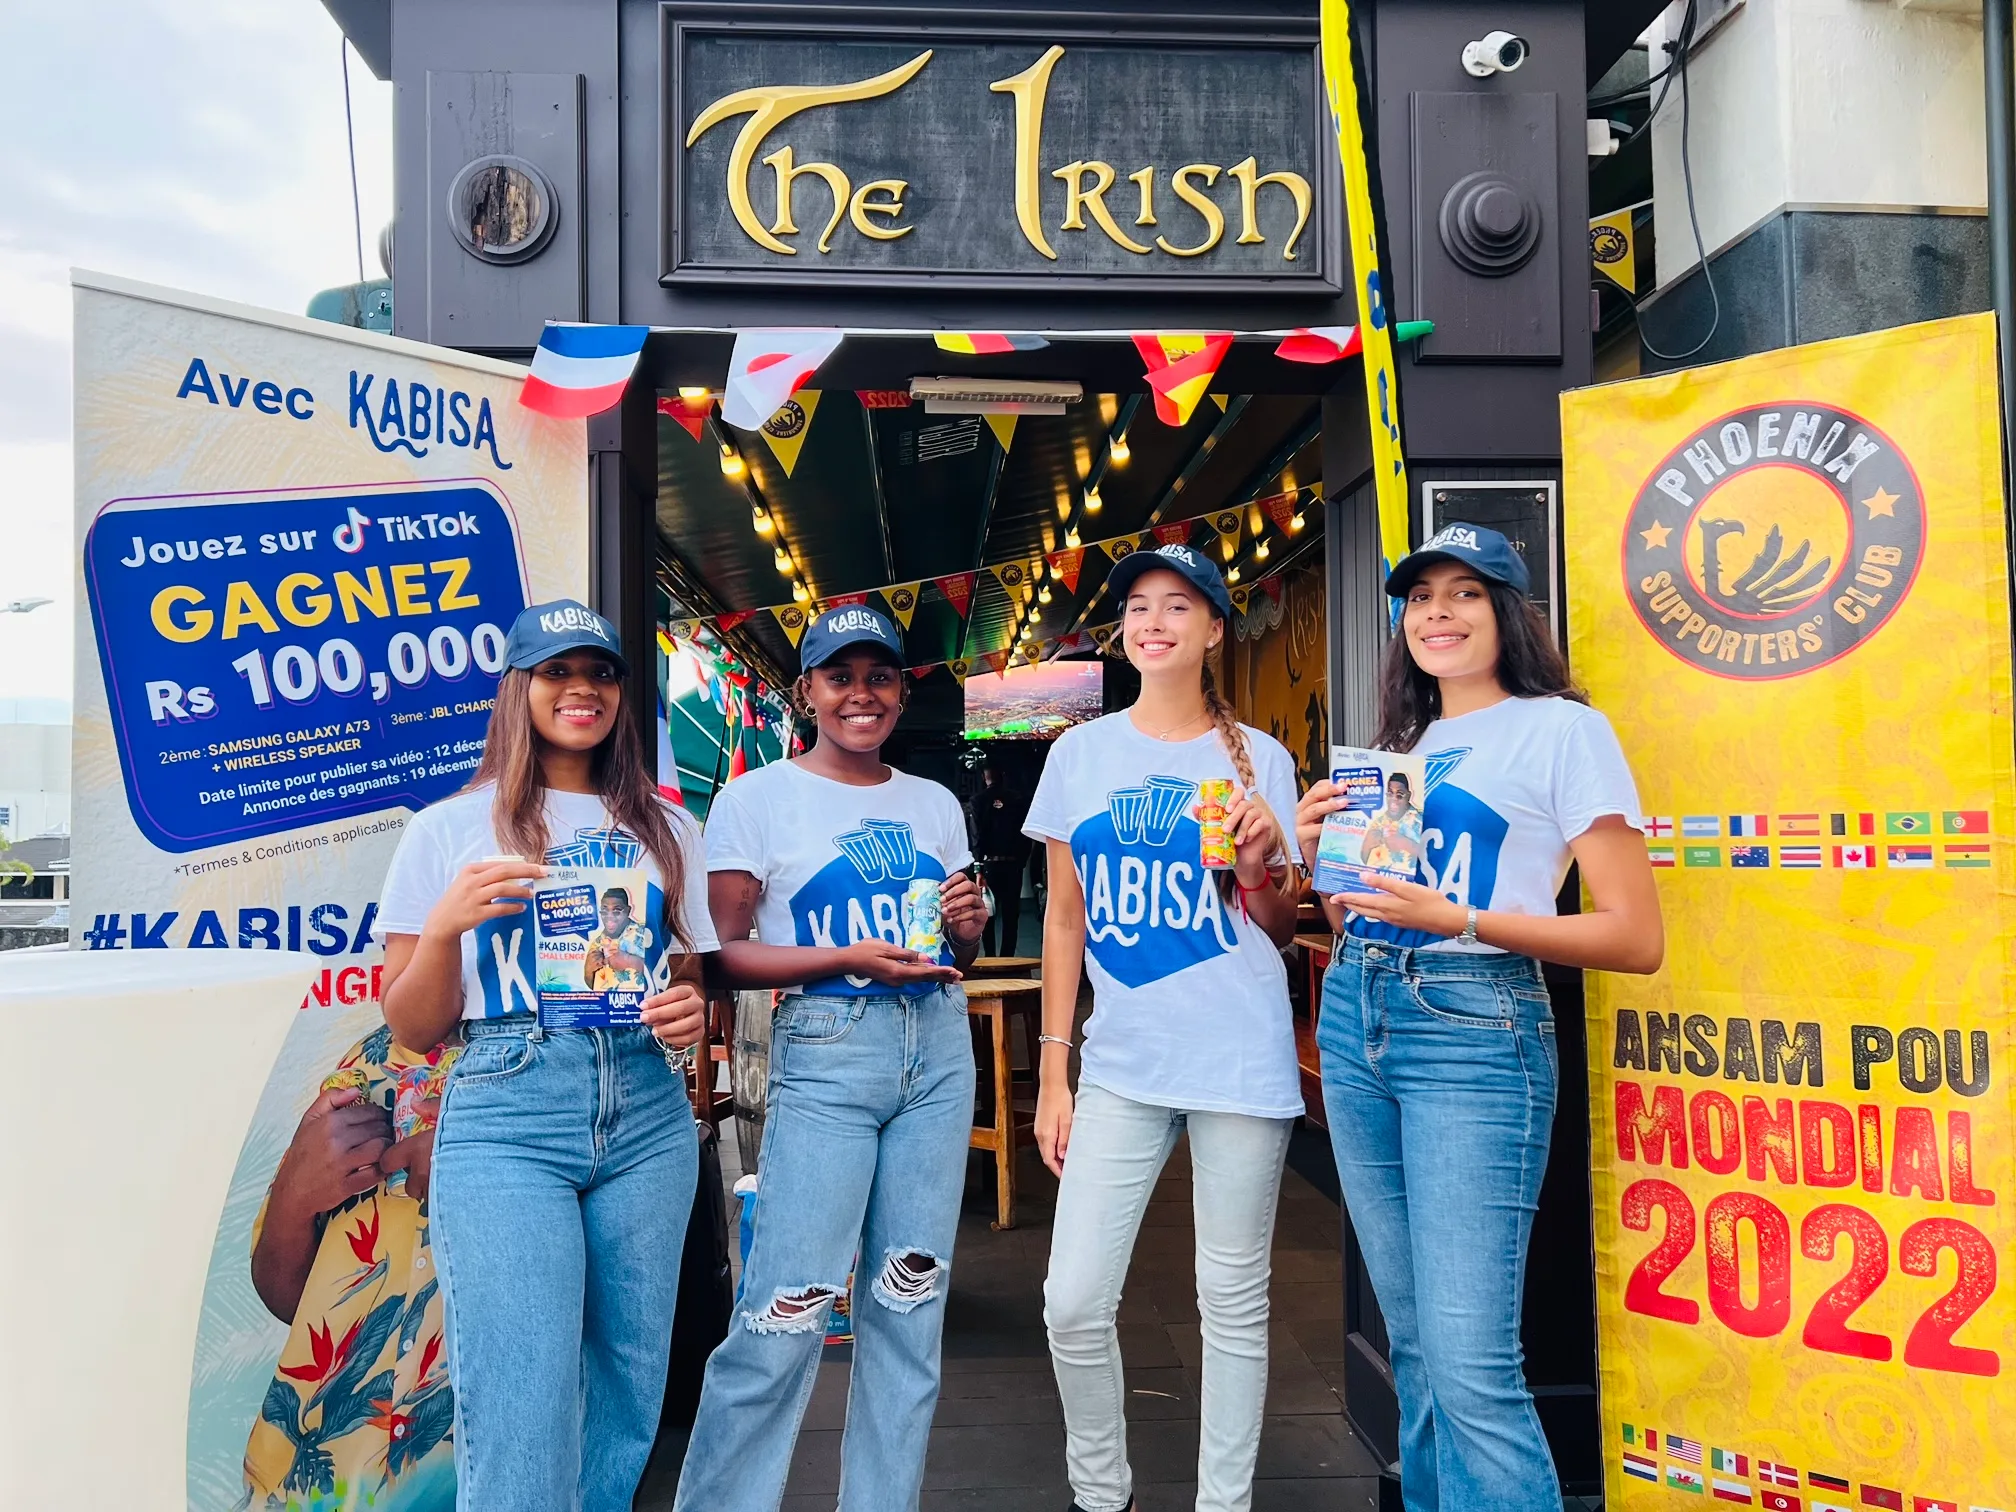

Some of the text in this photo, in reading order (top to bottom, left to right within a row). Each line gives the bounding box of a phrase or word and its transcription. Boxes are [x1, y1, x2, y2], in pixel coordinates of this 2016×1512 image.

[686, 48, 933, 255] The
[176, 357, 512, 470] Avec KABISA
[1655, 411, 1880, 507] PHOENIX
[120, 510, 481, 569] Jouez sur TikTok
[150, 556, 480, 643] GAGNEZ
[1641, 545, 1903, 665] SUPPORTERS' CLUB
[539, 607, 610, 642] KABISA
[828, 610, 886, 639] KABISA
[145, 621, 505, 721] Rs 100,000
[208, 733, 283, 757] SAMSUNG
[285, 723, 341, 744] GALAXY
[345, 719, 371, 735] A73
[429, 707, 452, 720] JBL
[199, 788, 236, 805] Date
[238, 779, 281, 797] limite
[284, 772, 317, 791] pour
[320, 762, 368, 784] publier
[371, 759, 387, 771] sa
[389, 750, 424, 767] vidéo
[434, 744, 451, 758] 12
[211, 738, 362, 773] + WIRELESS SPEAKER
[242, 793, 307, 816] Annonce
[309, 787, 335, 802] des
[338, 772, 400, 799] gagnants
[410, 767, 426, 781] 19
[242, 850, 253, 864] &
[255, 835, 329, 861] Conditions
[332, 817, 404, 843] applicables
[540, 905, 594, 921] Rs 100,000
[541, 895, 590, 910] GAGNEZ
[538, 942, 586, 952] #KABISA
[538, 952, 585, 961] CHALLENGE
[608, 992, 641, 1009] KABISA
[1613, 1008, 1990, 1098] ANSAM POU
[1613, 1080, 1996, 1207] MONDIAL
[1620, 1178, 2001, 1378] 2022
